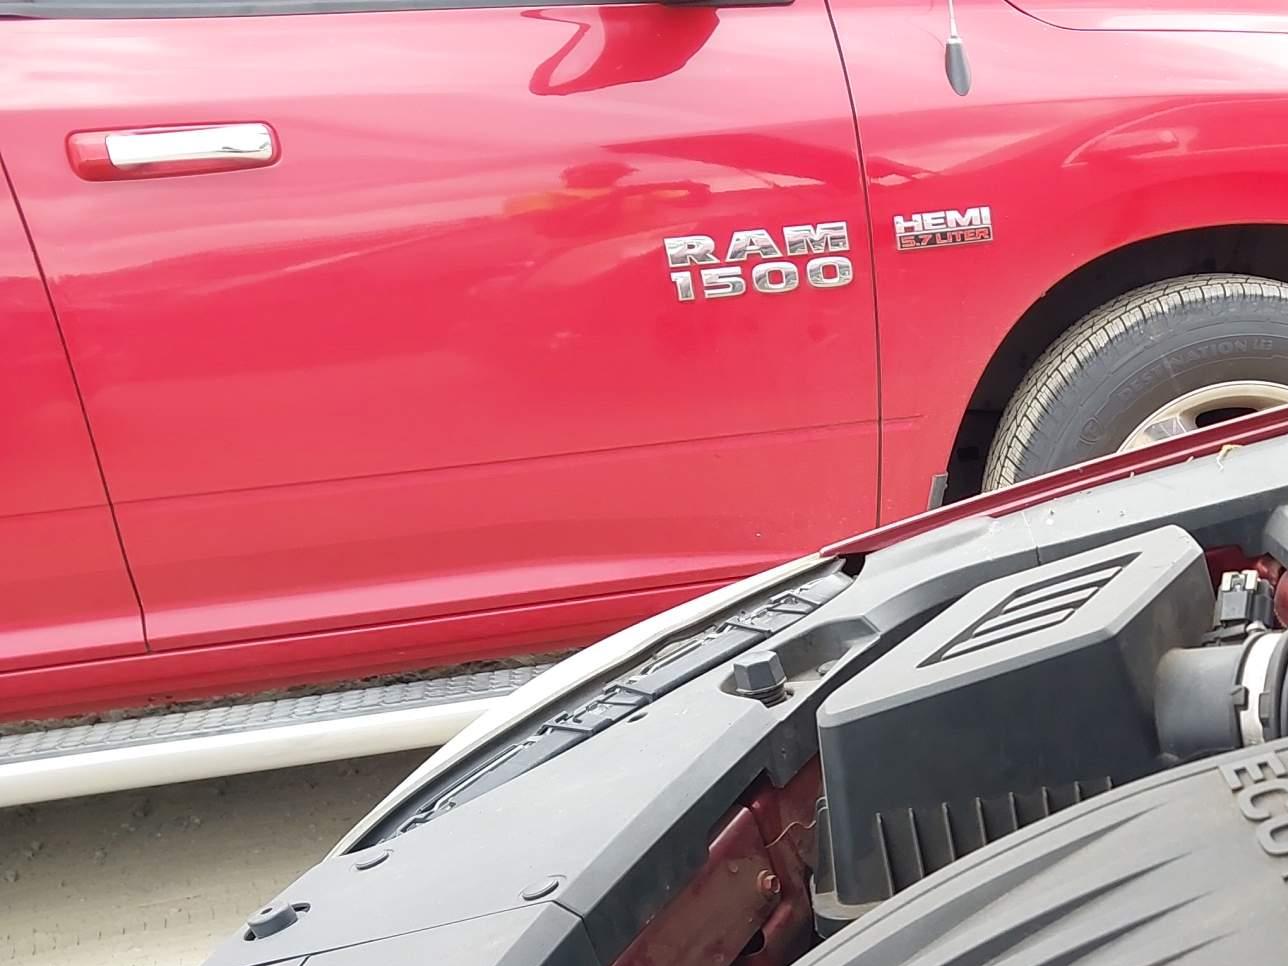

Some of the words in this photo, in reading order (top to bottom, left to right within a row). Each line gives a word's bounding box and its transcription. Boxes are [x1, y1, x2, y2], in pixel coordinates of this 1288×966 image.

[894, 206, 992, 233] HEMI
[900, 234, 933, 249] 5.7
[937, 228, 990, 245] LITER
[664, 221, 851, 267] RAM
[670, 256, 854, 301] 1500
[1116, 338, 1248, 400] DESTINATION
